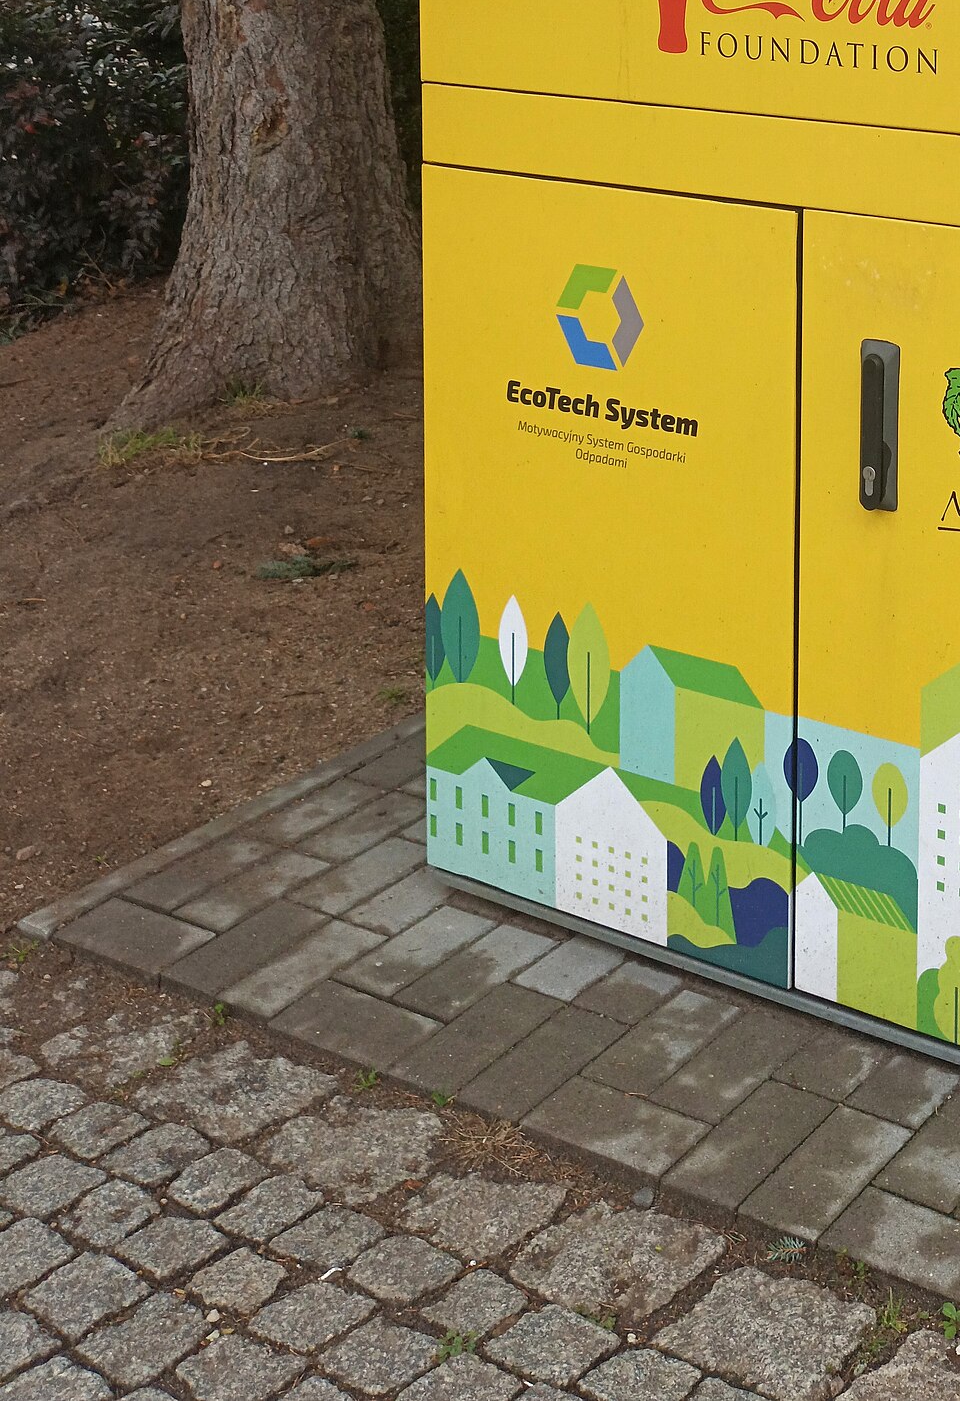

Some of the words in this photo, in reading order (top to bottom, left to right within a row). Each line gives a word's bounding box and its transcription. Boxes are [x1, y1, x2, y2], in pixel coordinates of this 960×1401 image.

[700, 31, 939, 75] FOUNDATION
[506, 380, 600, 418] EcoTech
[605, 398, 699, 437] System
[518, 420, 585, 444] Motywacyjny
[586, 434, 624, 451] System
[627, 441, 686, 464] Gospodarki
[575, 448, 628, 469] Odpadami
